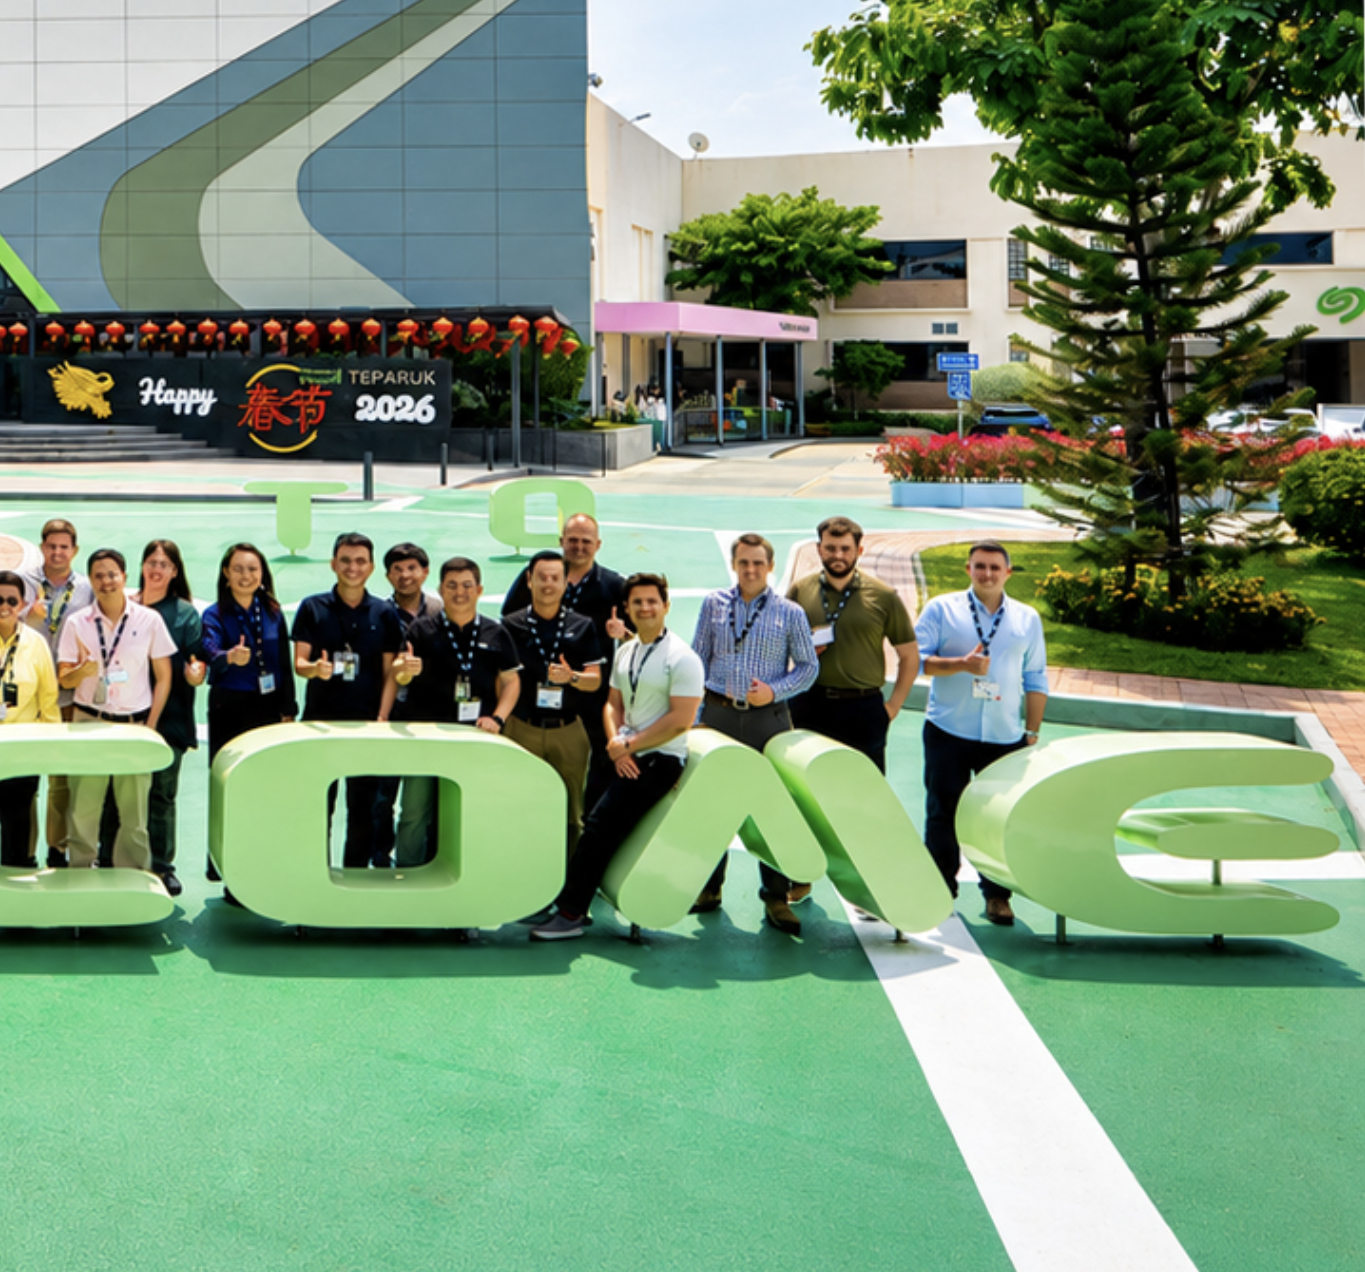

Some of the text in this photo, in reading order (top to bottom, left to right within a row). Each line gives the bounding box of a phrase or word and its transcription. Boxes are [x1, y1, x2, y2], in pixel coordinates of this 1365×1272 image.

[138, 376, 436, 434] Happy 春节 2026
[348, 369, 436, 386] TEPARUK
[243, 477, 596, 550] TO
